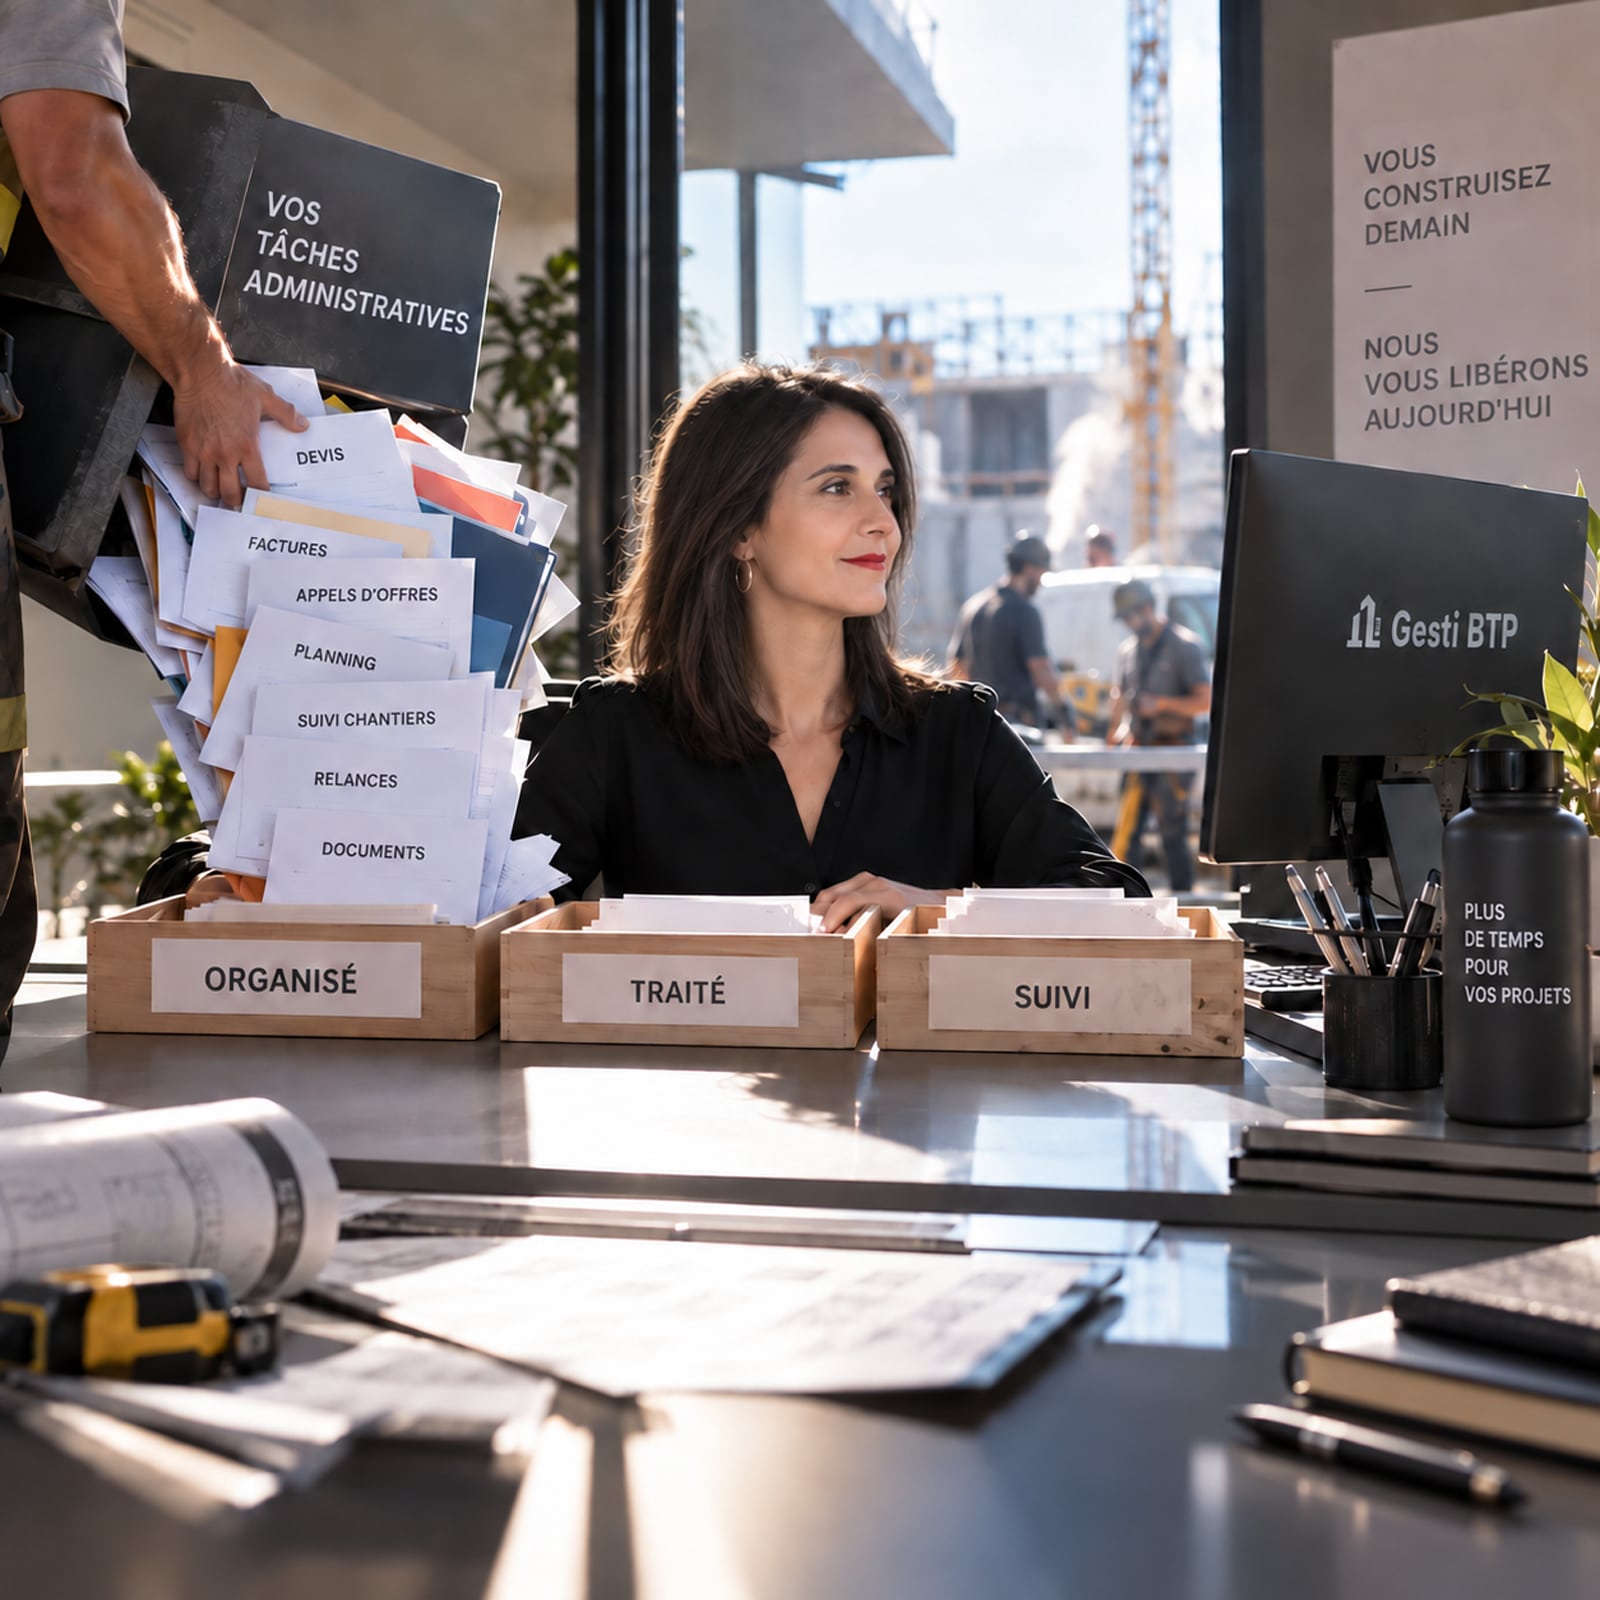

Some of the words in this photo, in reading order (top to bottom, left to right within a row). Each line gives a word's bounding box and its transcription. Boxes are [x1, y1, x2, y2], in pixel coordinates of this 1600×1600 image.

[1363, 143, 1436, 175] VOUS
[1364, 163, 1552, 211] CONSTRUISEZ
[268, 190, 321, 226] VOS
[1365, 211, 1470, 246] DEMAIN
[257, 228, 360, 274] TÂCHES
[242, 269, 470, 335] ADMINISTRATIVES
[1364, 331, 1439, 361] NOUS
[1364, 367, 1439, 396] VOUS
[1450, 353, 1589, 389] LIBÉRONS
[1364, 394, 1551, 432] AUJOURD'HUI
[296, 447, 345, 466] DEVIS
[248, 536, 328, 558] FACTURES
[295, 587, 357, 603] APPELS
[361, 587, 438, 602] D'OFFRES
[1391, 609, 1460, 648] Gesti
[1467, 612, 1519, 649] BTP
[294, 643, 377, 671] PLANNING
[297, 713, 340, 728] SUIVI
[343, 710, 436, 727] CHANTIERS
[314, 771, 398, 789] RELANCES
[321, 841, 425, 861] DOCUMENTS
[1465, 902, 1506, 921] PLUS
[1465, 930, 1485, 948] DE
[1487, 930, 1544, 949] TEMPS
[204, 962, 357, 995] ORGANISÉ
[1465, 957, 1509, 976] POUR
[630, 975, 726, 1005] TRAITÉ
[1014, 984, 1090, 1010] SUIVI
[1464, 985, 1497, 1004] VOS
[1501, 986, 1572, 1005] PROJETS
